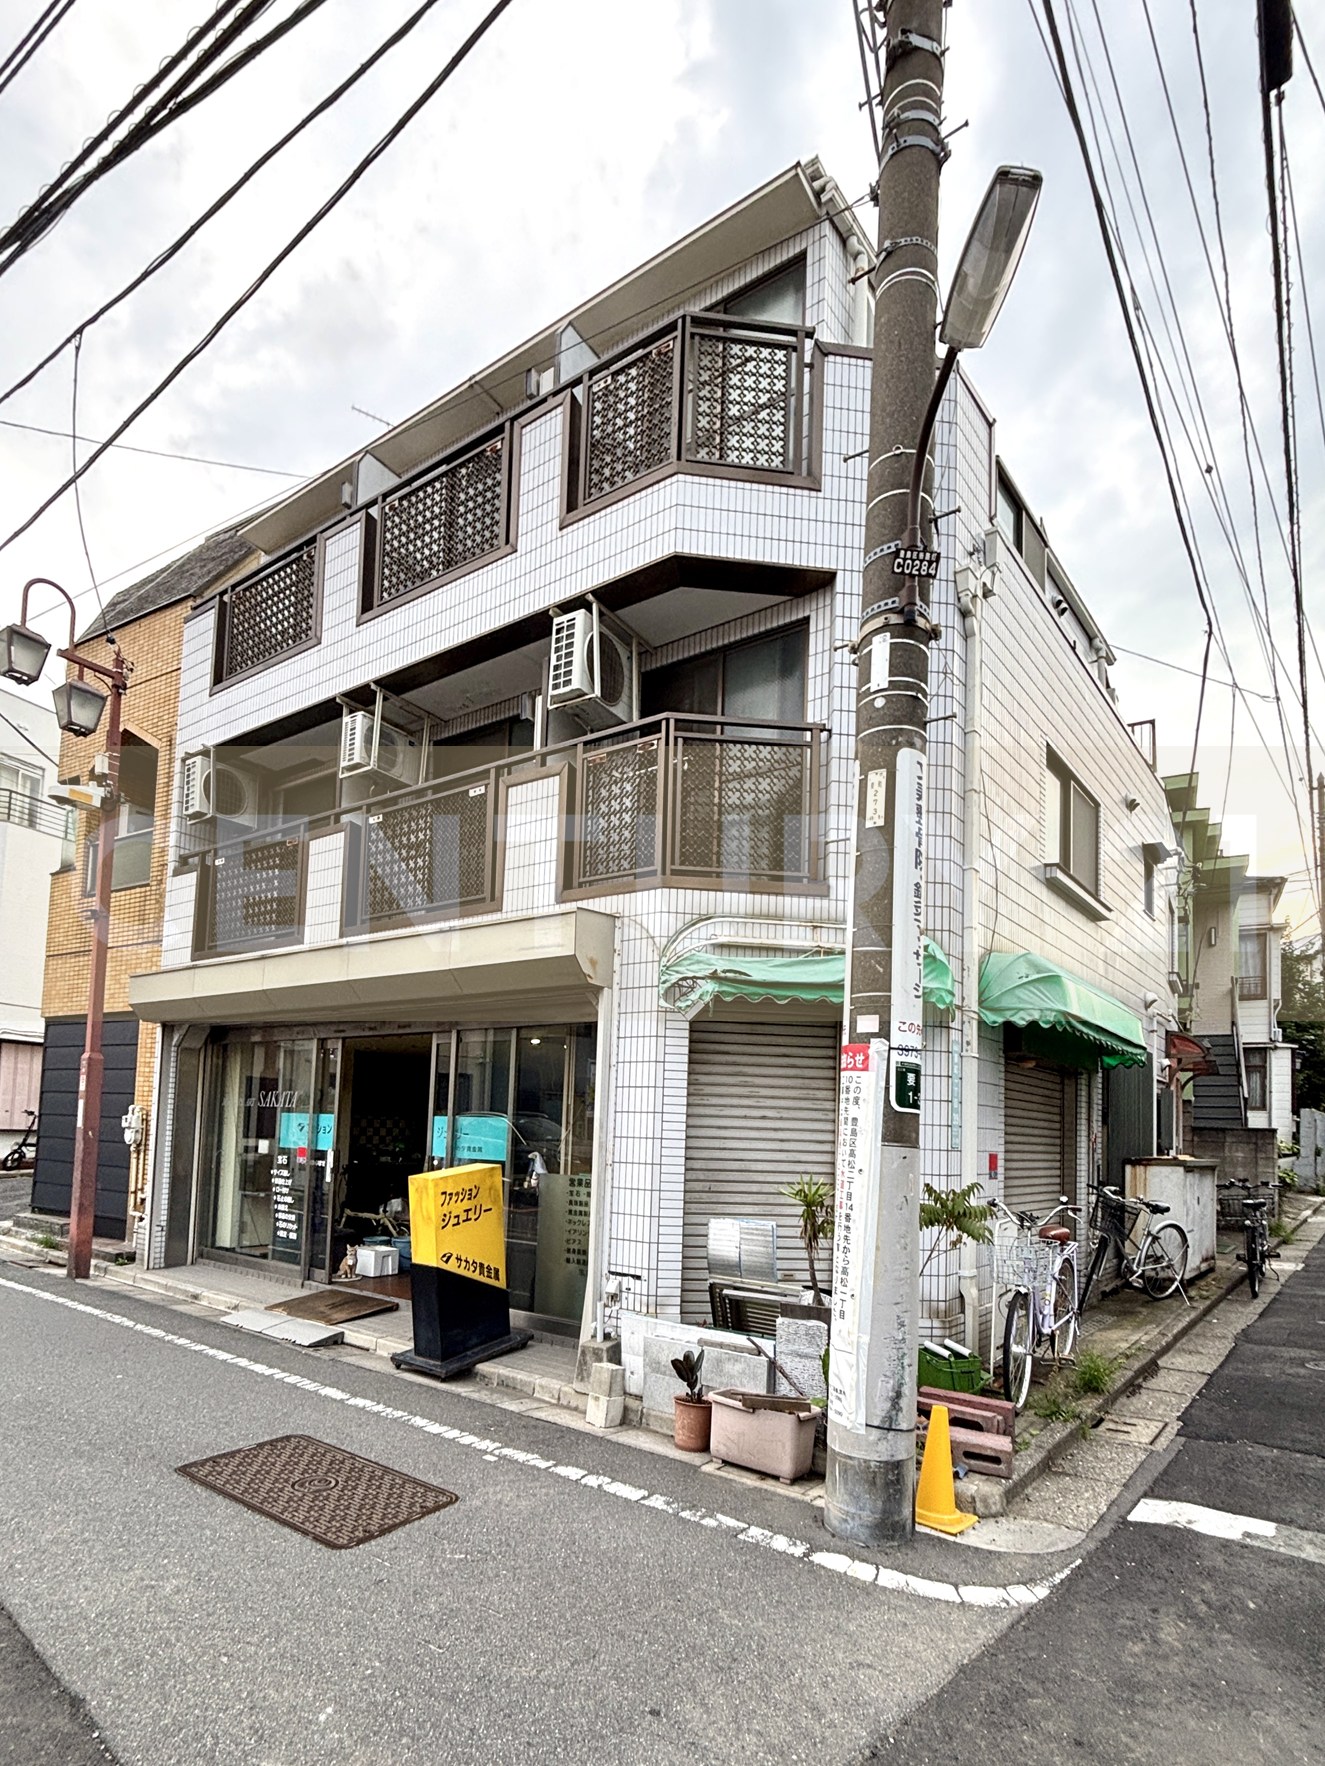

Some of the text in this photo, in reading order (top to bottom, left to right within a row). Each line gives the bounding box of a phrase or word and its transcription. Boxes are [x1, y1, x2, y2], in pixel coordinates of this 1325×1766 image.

[893, 558, 937, 576] C0284
[257, 1090, 298, 1108] SAKATA
[441, 1184, 480, 1207] ファッション
[441, 1204, 493, 1230] ジュエリー
[455, 1253, 500, 1282] サカタ貴金属
